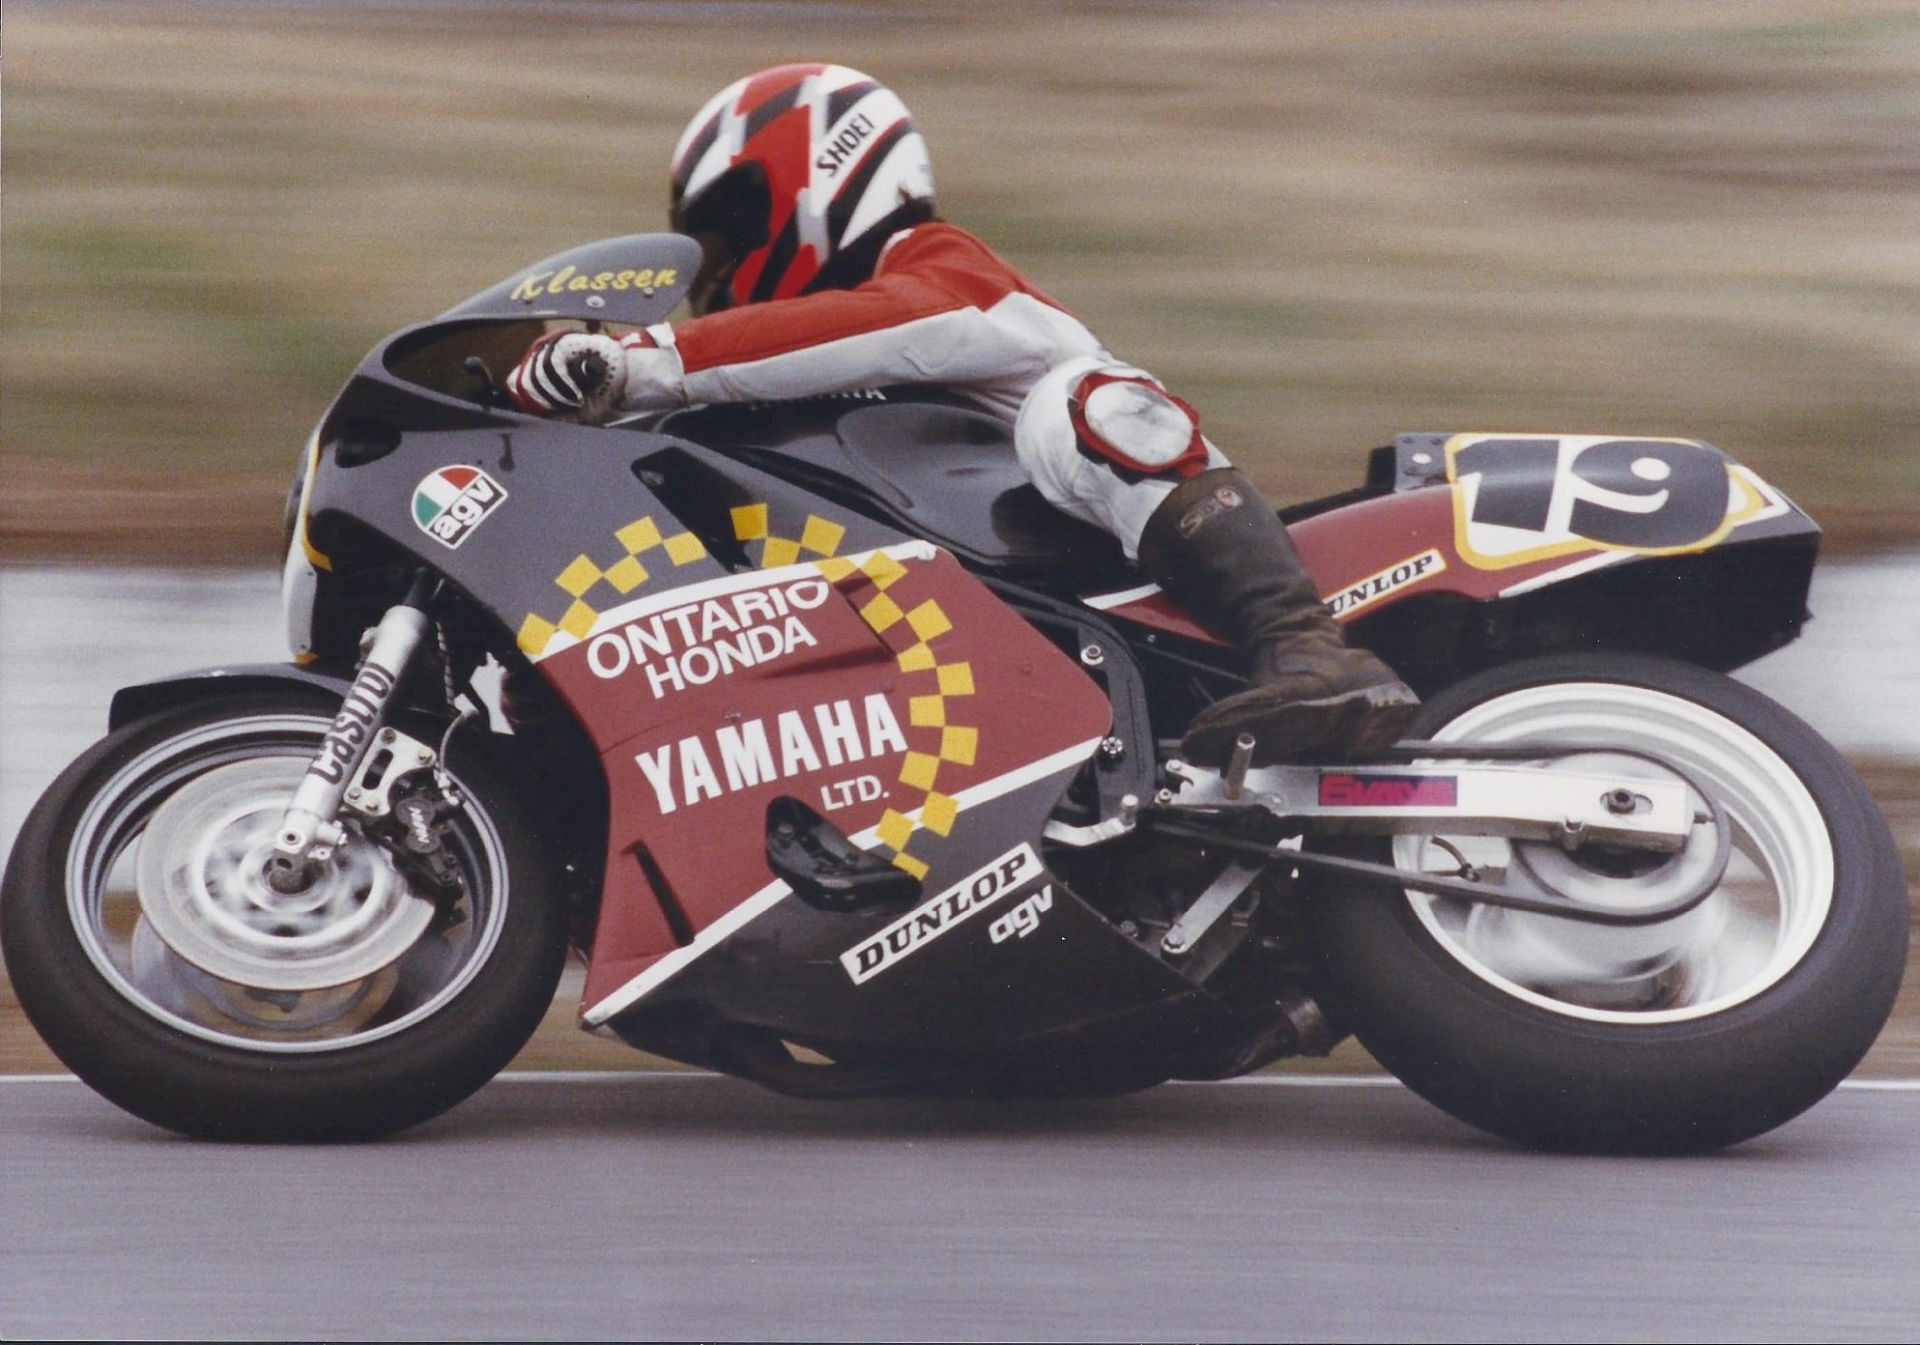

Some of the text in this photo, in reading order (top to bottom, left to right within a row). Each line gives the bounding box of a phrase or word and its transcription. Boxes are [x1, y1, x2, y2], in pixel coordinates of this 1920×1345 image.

[816, 112, 875, 177] SHOEI
[510, 265, 677, 300] Klassen
[433, 476, 494, 540] agv
[1455, 439, 1730, 548] 19
[1327, 554, 1432, 615] UNLOP
[587, 580, 829, 679] ONTARIO
[645, 615, 818, 700] HONDA
[635, 693, 909, 814] YAMAHA
[820, 775, 890, 811] LTD.
[855, 852, 1026, 976] DUNLOP
[988, 884, 1053, 944] agv
